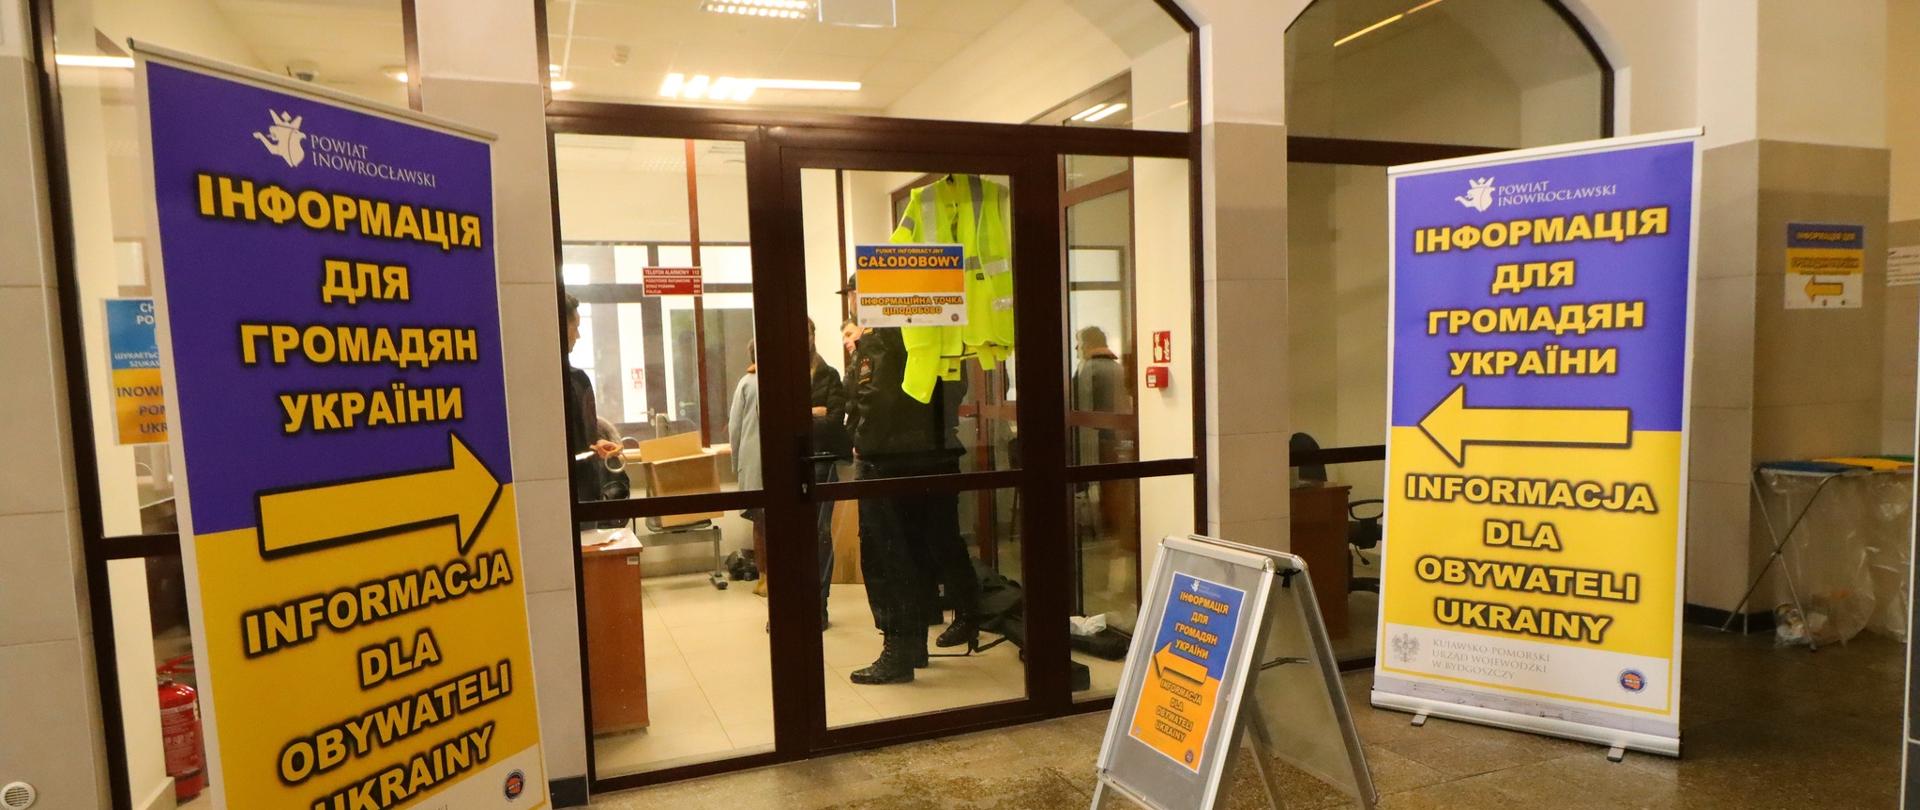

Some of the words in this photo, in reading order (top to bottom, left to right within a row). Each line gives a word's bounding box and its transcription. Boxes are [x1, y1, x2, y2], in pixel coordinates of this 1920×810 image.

[310, 135, 368, 160] POWIAT
[312, 151, 437, 188] INOWROCŁAWSKI
[1498, 184, 1617, 207] INOWROCŁAWSKI
[1499, 181, 1549, 196] POWIAT
[198, 173, 481, 250] ІНФОРМАЦІЯ
[1414, 206, 1669, 254] ІНФОРМАЦІЯ
[857, 255, 960, 268] CAŁODOBOWY
[1491, 260, 1575, 295] ДЛЯ
[322, 259, 410, 305] ДЛЯ
[1428, 301, 1645, 335] ГРОМАДЯН
[240, 324, 478, 368] ГРОМАДЯН
[1450, 345, 1617, 376] УКРАЇНИ
[279, 382, 464, 433] УКРАЇНИ
[1406, 474, 1657, 512] INFORMACJA
[1485, 520, 1560, 550] DLA
[1416, 556, 1639, 601] OBYWATELI
[245, 552, 512, 655] INFORMACJA
[1179, 591, 1229, 615] ІНФОРМАЦІЯ
[1191, 611, 1209, 625] ДЛЯ
[1436, 599, 1611, 642] UKRAINY
[1174, 622, 1219, 646] ГРОМАДЯН
[1175, 639, 1209, 660] УКРАЇНИ
[360, 632, 439, 686] DLA
[280, 663, 511, 783] OBYWATELI
